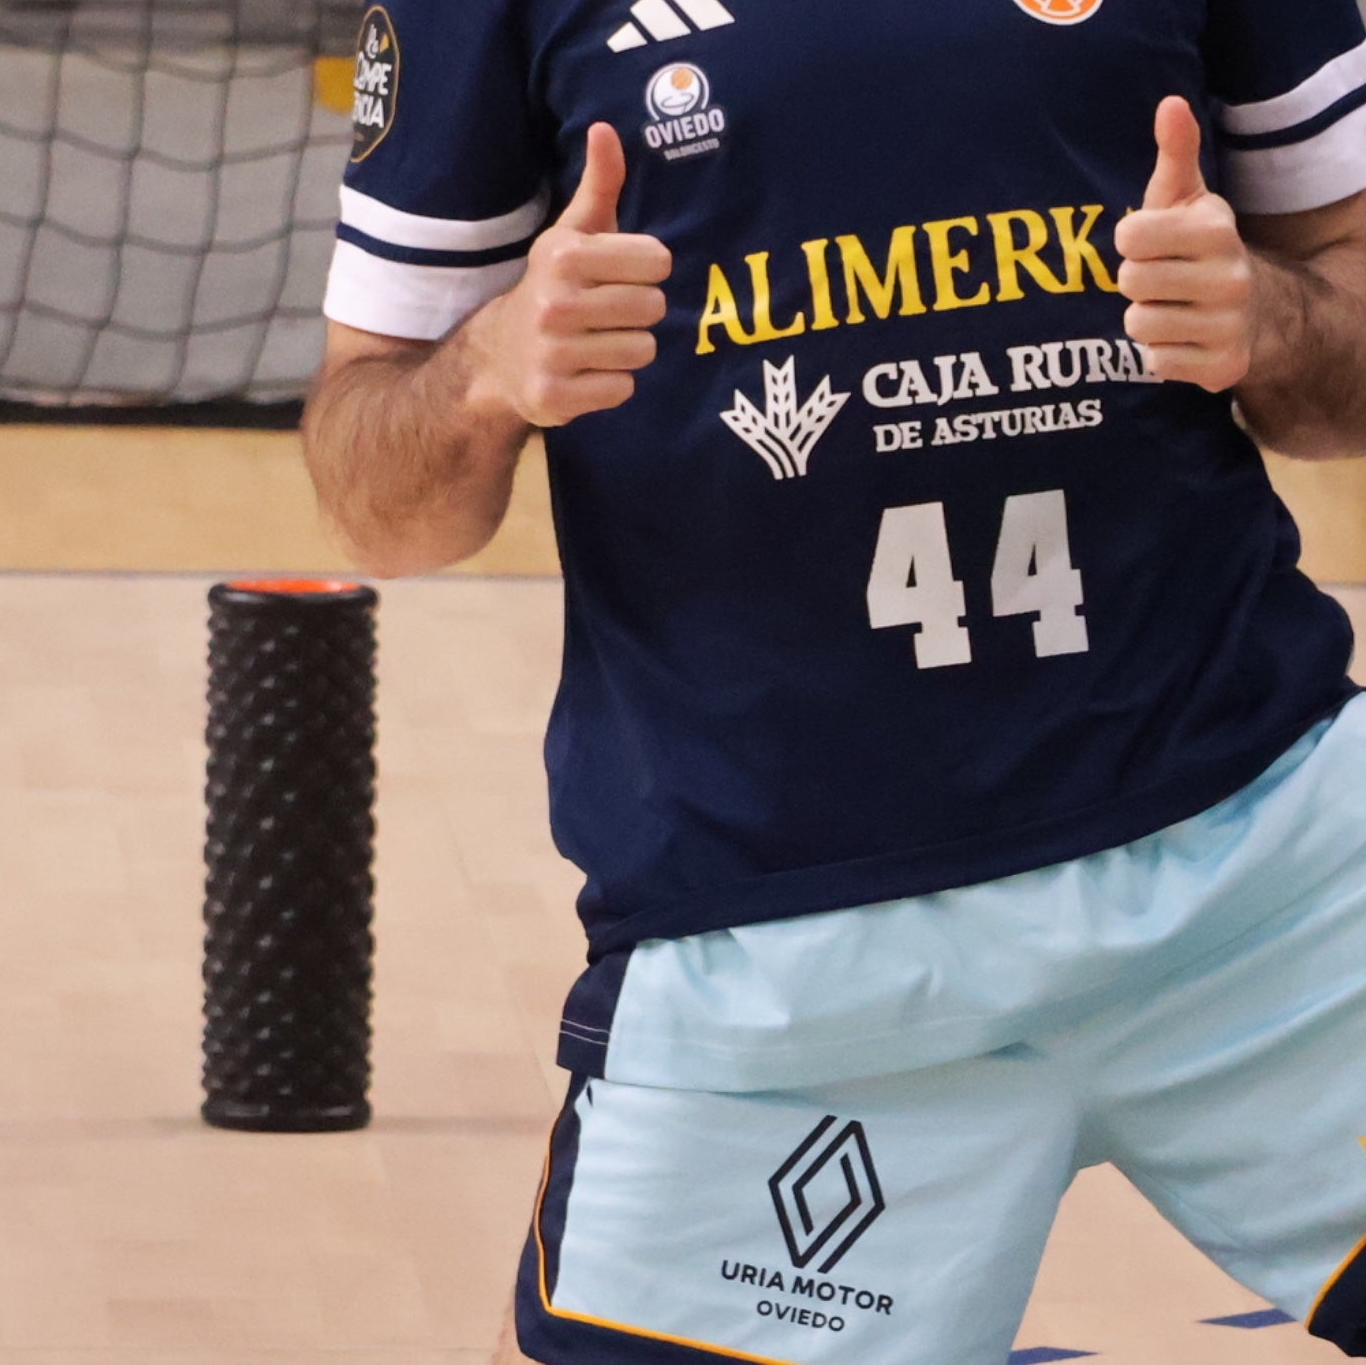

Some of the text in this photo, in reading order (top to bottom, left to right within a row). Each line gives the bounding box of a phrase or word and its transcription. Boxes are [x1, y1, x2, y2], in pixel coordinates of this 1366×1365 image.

[644, 108, 725, 148] OVIEDO
[695, 204, 1137, 355] ALIMERK
[862, 351, 999, 408] CAJA
[872, 399, 1103, 453] DE ASTURIAS
[866, 489, 1089, 669] 44
[721, 1260, 894, 1315] URIA MOTOR
[756, 1300, 845, 1332] OVIEDO
